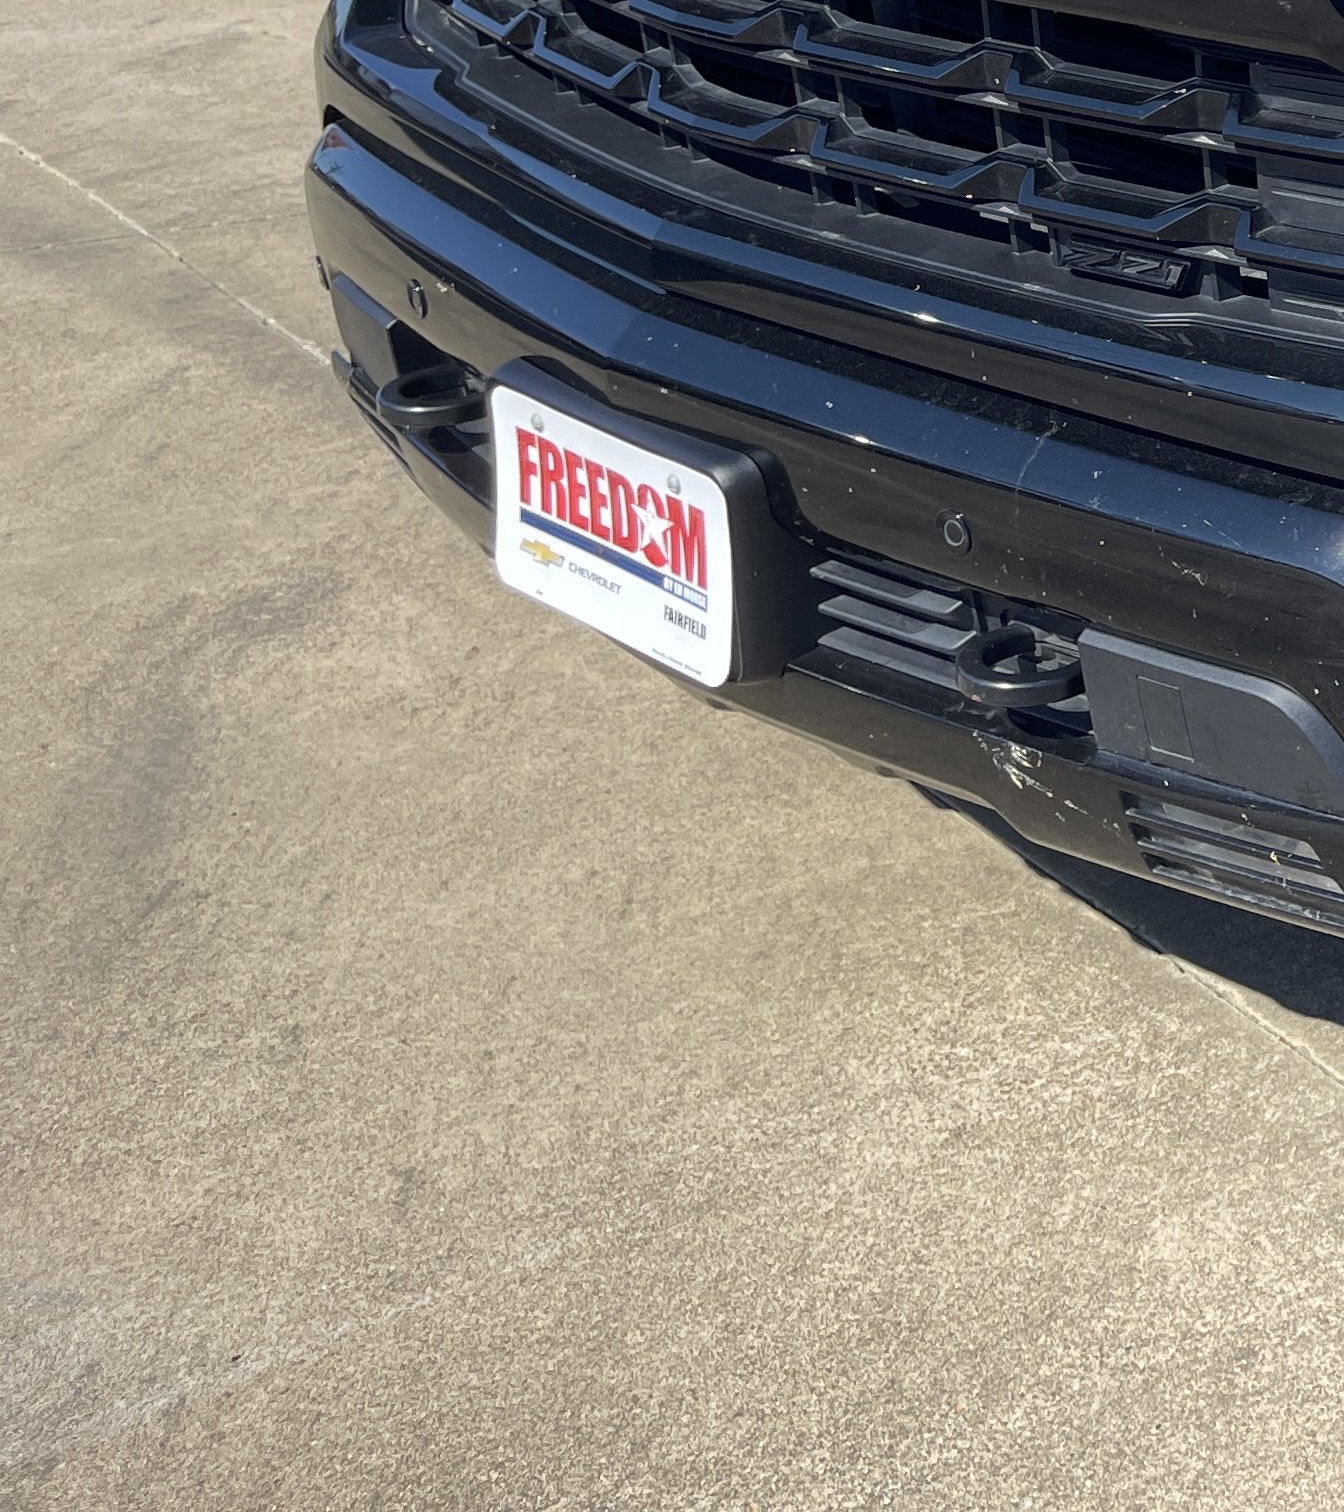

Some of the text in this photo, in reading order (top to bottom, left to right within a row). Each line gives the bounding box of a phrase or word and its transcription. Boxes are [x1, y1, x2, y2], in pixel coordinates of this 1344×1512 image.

[514, 425, 708, 591] FREEDOM
[568, 560, 622, 595] CHEVROLET
[663, 603, 707, 640] FAIRFIELD
